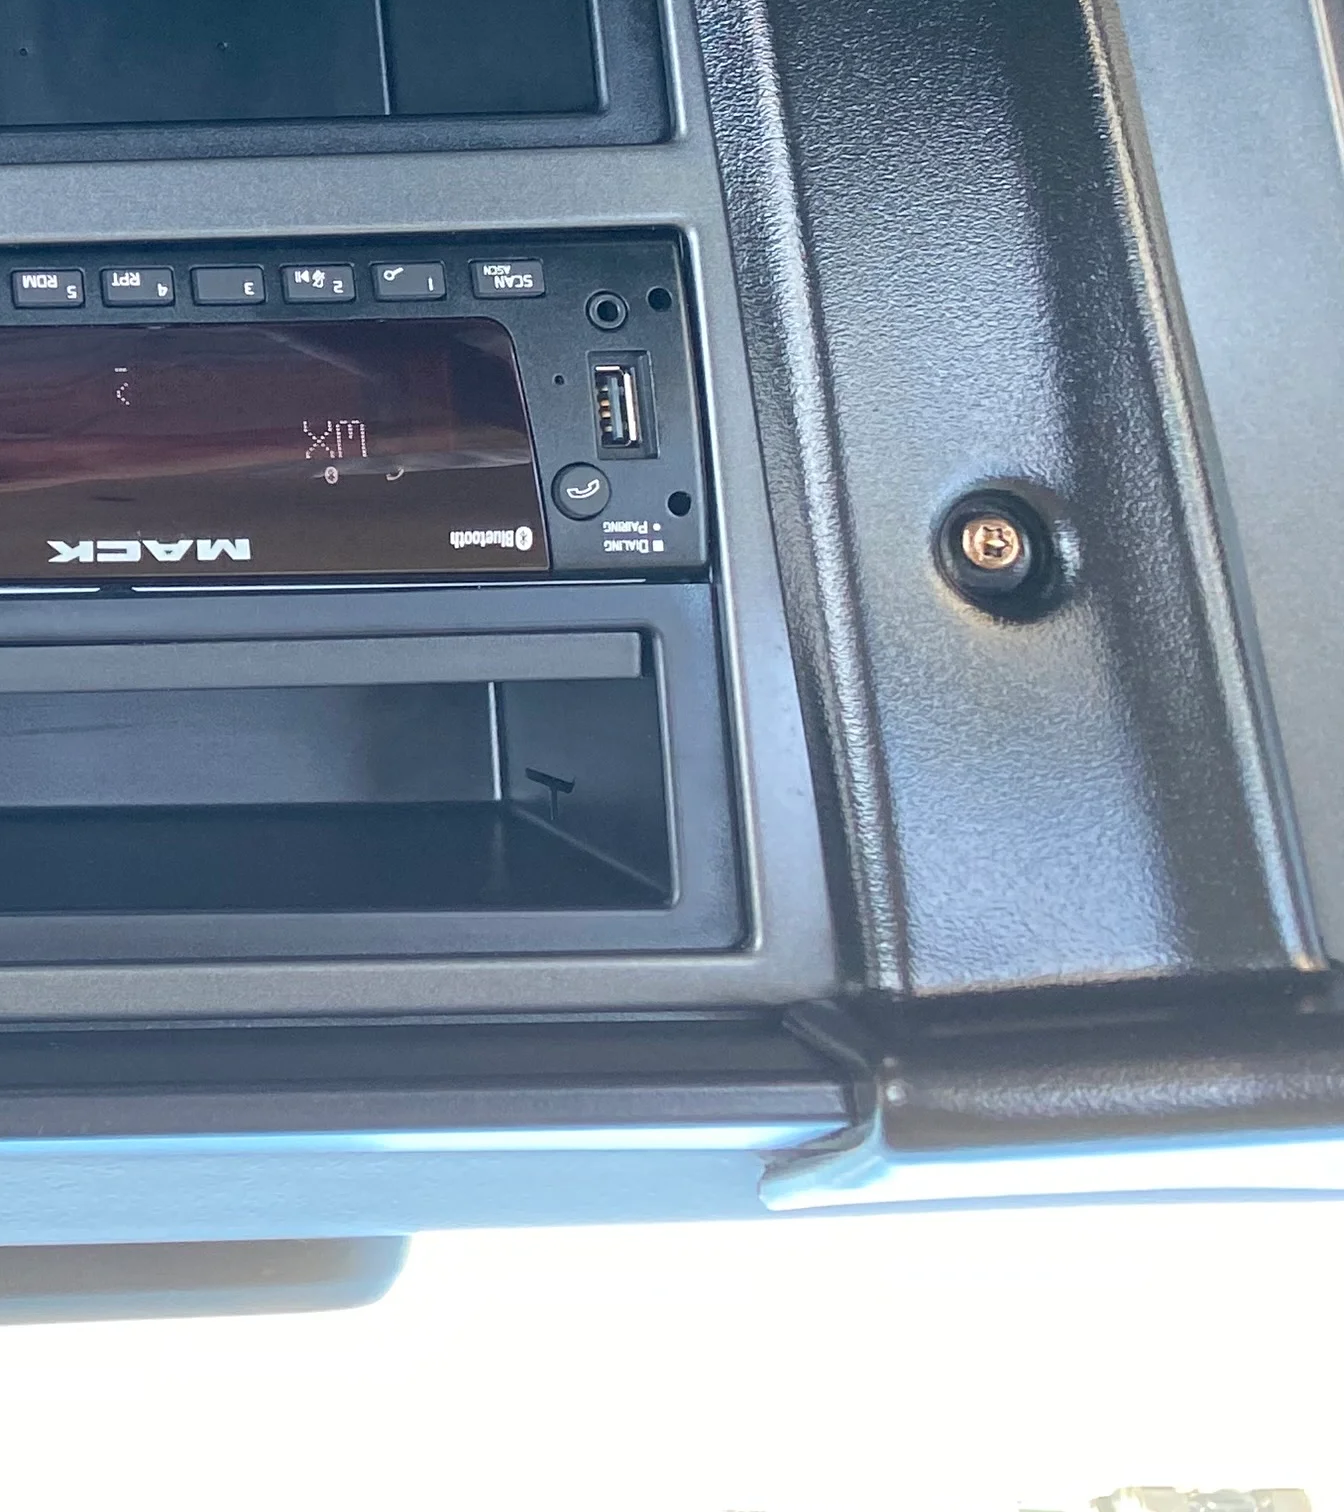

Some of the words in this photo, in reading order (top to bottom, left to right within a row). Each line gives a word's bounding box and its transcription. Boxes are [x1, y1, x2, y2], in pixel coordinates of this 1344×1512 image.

[23, 274, 58, 288] RDM
[112, 272, 140, 287] RPT
[333, 280, 344, 293] 2
[428, 277, 434, 291] 1
[494, 274, 533, 288] SCAN
[66, 285, 78, 298] 5
[157, 283, 168, 297] 4
[244, 282, 254, 295] 3
[450, 530, 514, 548] Bluetooth
[46, 538, 251, 562] MACK
